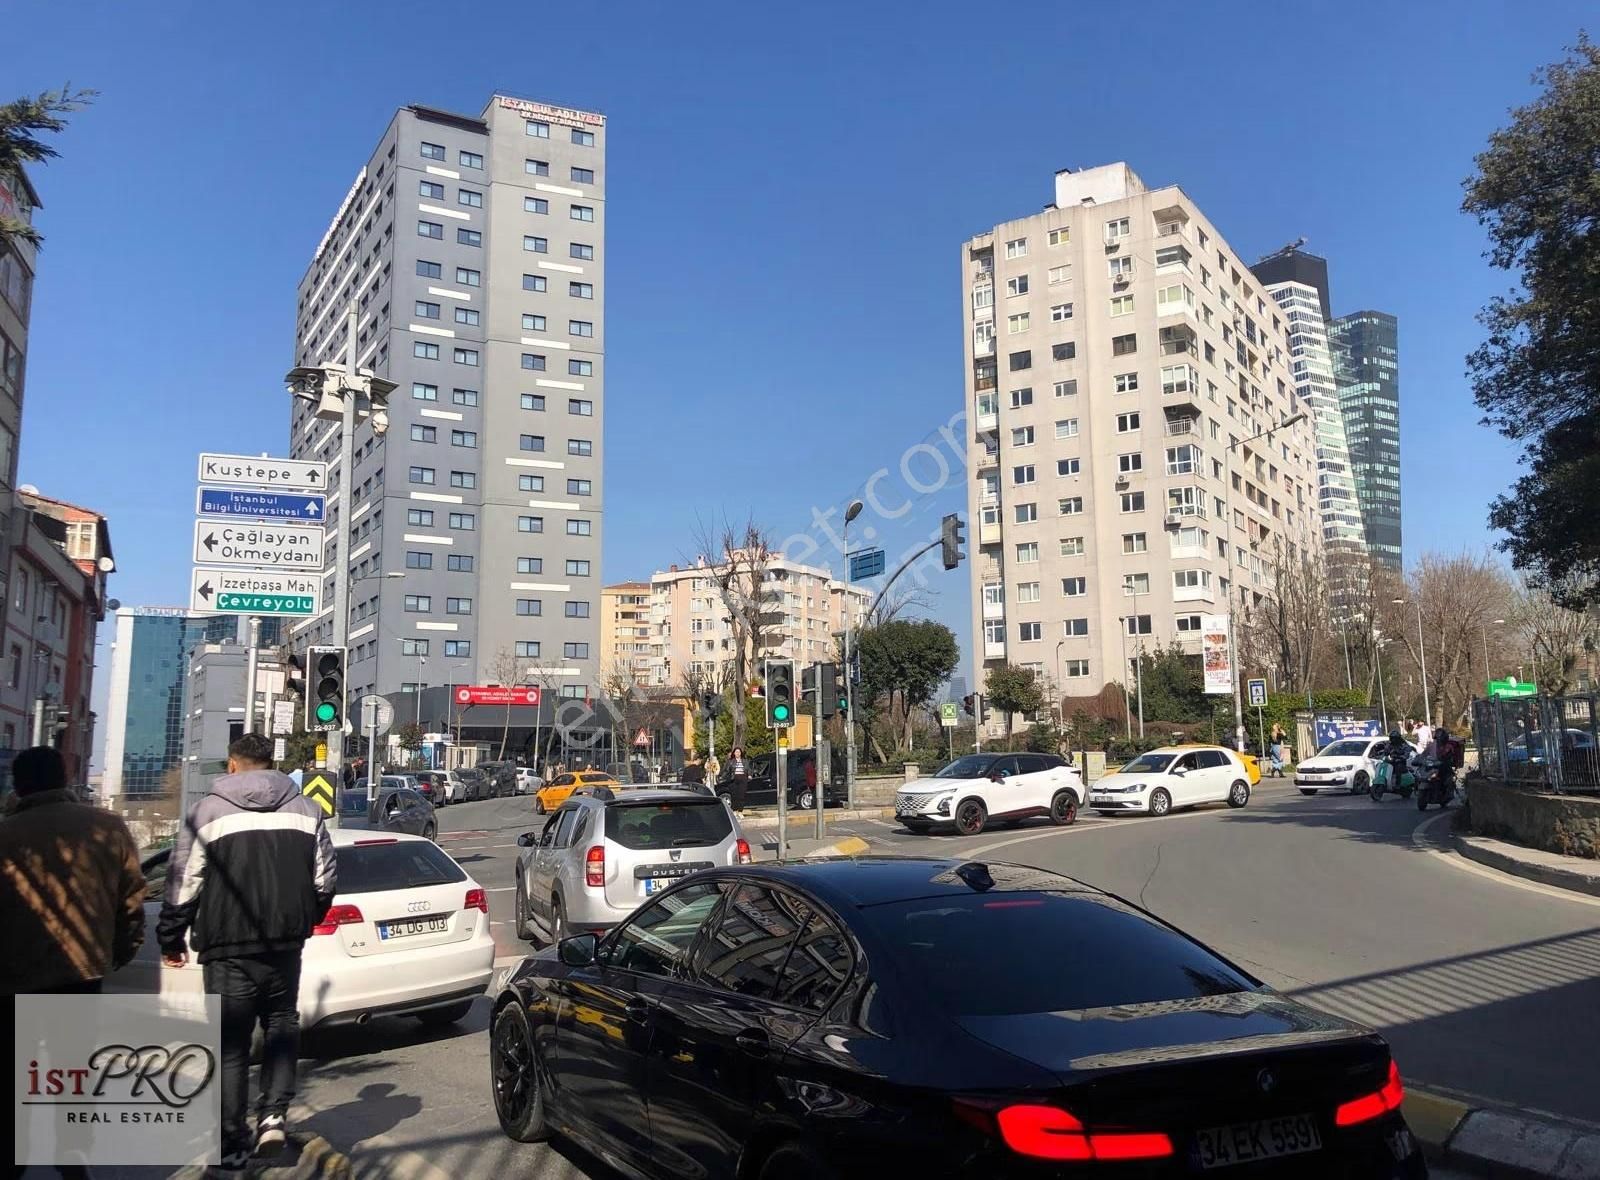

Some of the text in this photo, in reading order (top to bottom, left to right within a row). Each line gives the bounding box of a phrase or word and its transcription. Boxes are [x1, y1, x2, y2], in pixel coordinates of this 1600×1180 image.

[206, 462, 291, 481] Kuştepe
[230, 492, 278, 505] İstanbul
[204, 502, 300, 516] Bilgi Üniversitesi
[222, 528, 310, 546] Çağlayan
[221, 546, 318, 563] Okmeydanı
[219, 573, 317, 593] İzzetpaşa Mah.
[218, 594, 313, 611] Çevreyolu
[652, 868, 699, 876] DUSTER
[652, 879, 663, 890] 34
[389, 918, 446, 936] 34 DG 013
